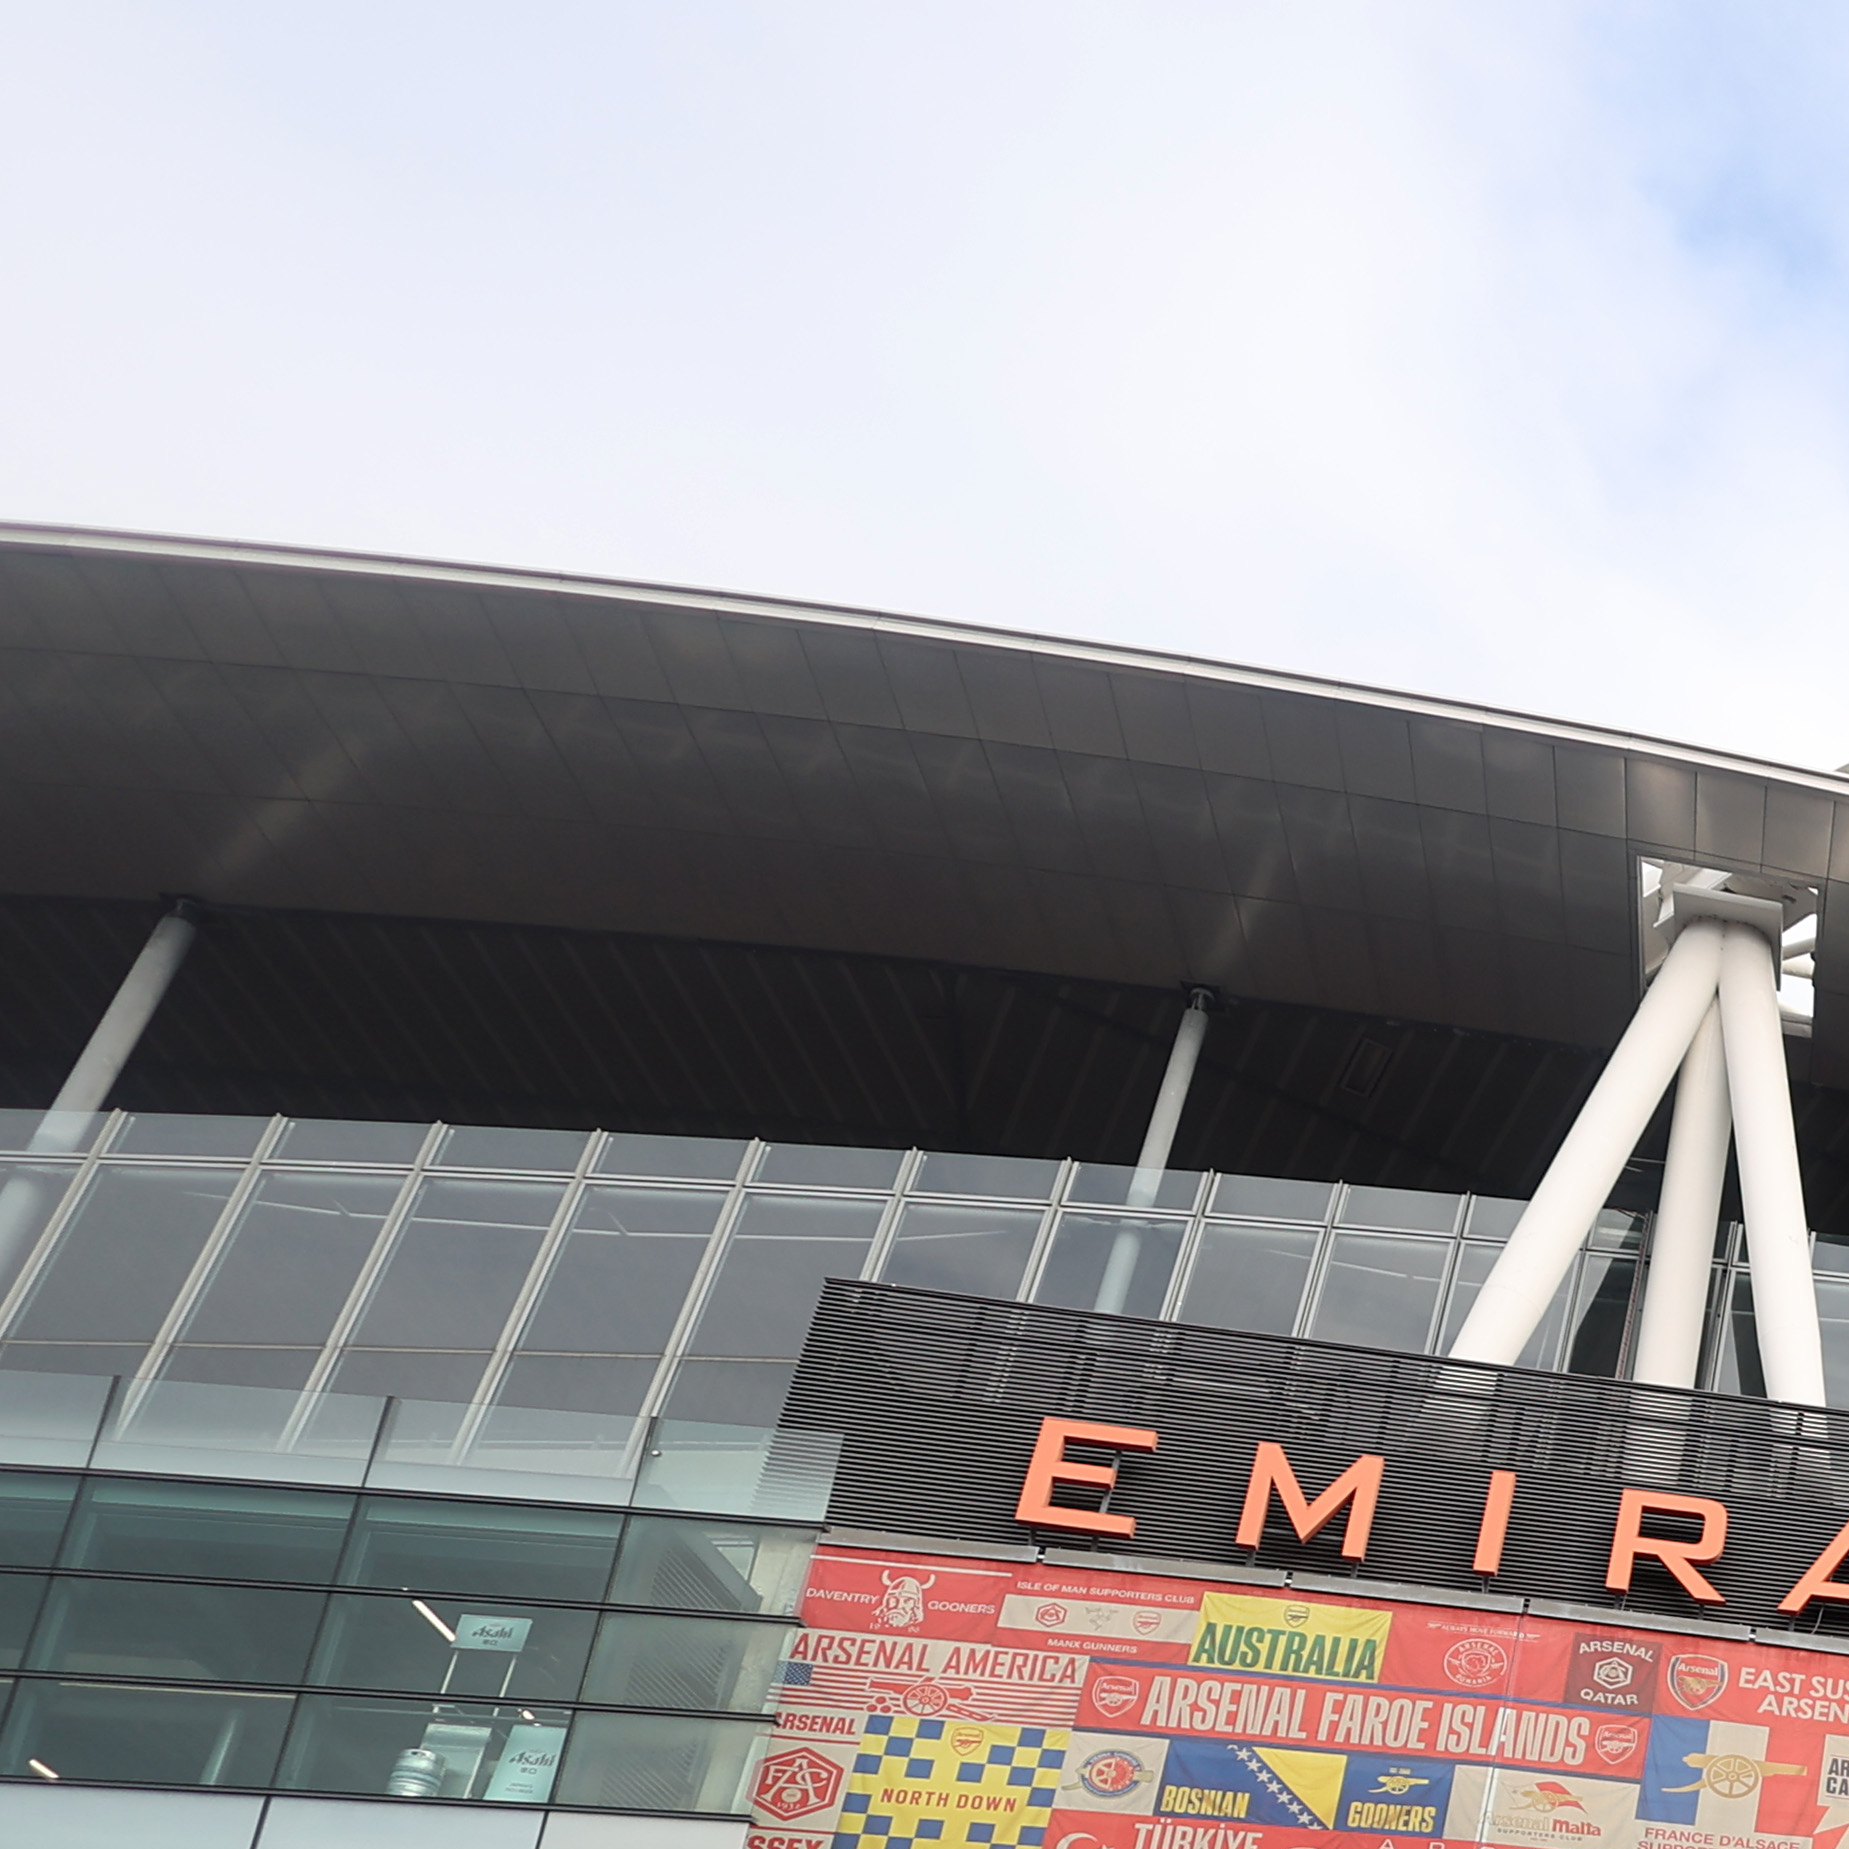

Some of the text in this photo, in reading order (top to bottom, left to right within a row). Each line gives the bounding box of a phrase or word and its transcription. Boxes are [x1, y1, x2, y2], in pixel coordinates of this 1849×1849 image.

[806, 1587, 996, 1615] DAVENTRY GOONERS
[790, 1636, 1077, 1684] ARSENAL AMERICA
[1192, 1621, 1378, 1681] AUSTRALIA
[1738, 1668, 1805, 1695] EAST
[1580, 1689, 1639, 1705] QATAR
[1140, 1676, 1590, 1765] ARSENAL FAROE ISLANDS
[881, 1789, 1017, 1812] NORTH DOWN
[1644, 1827, 1716, 1844] FRANCE
